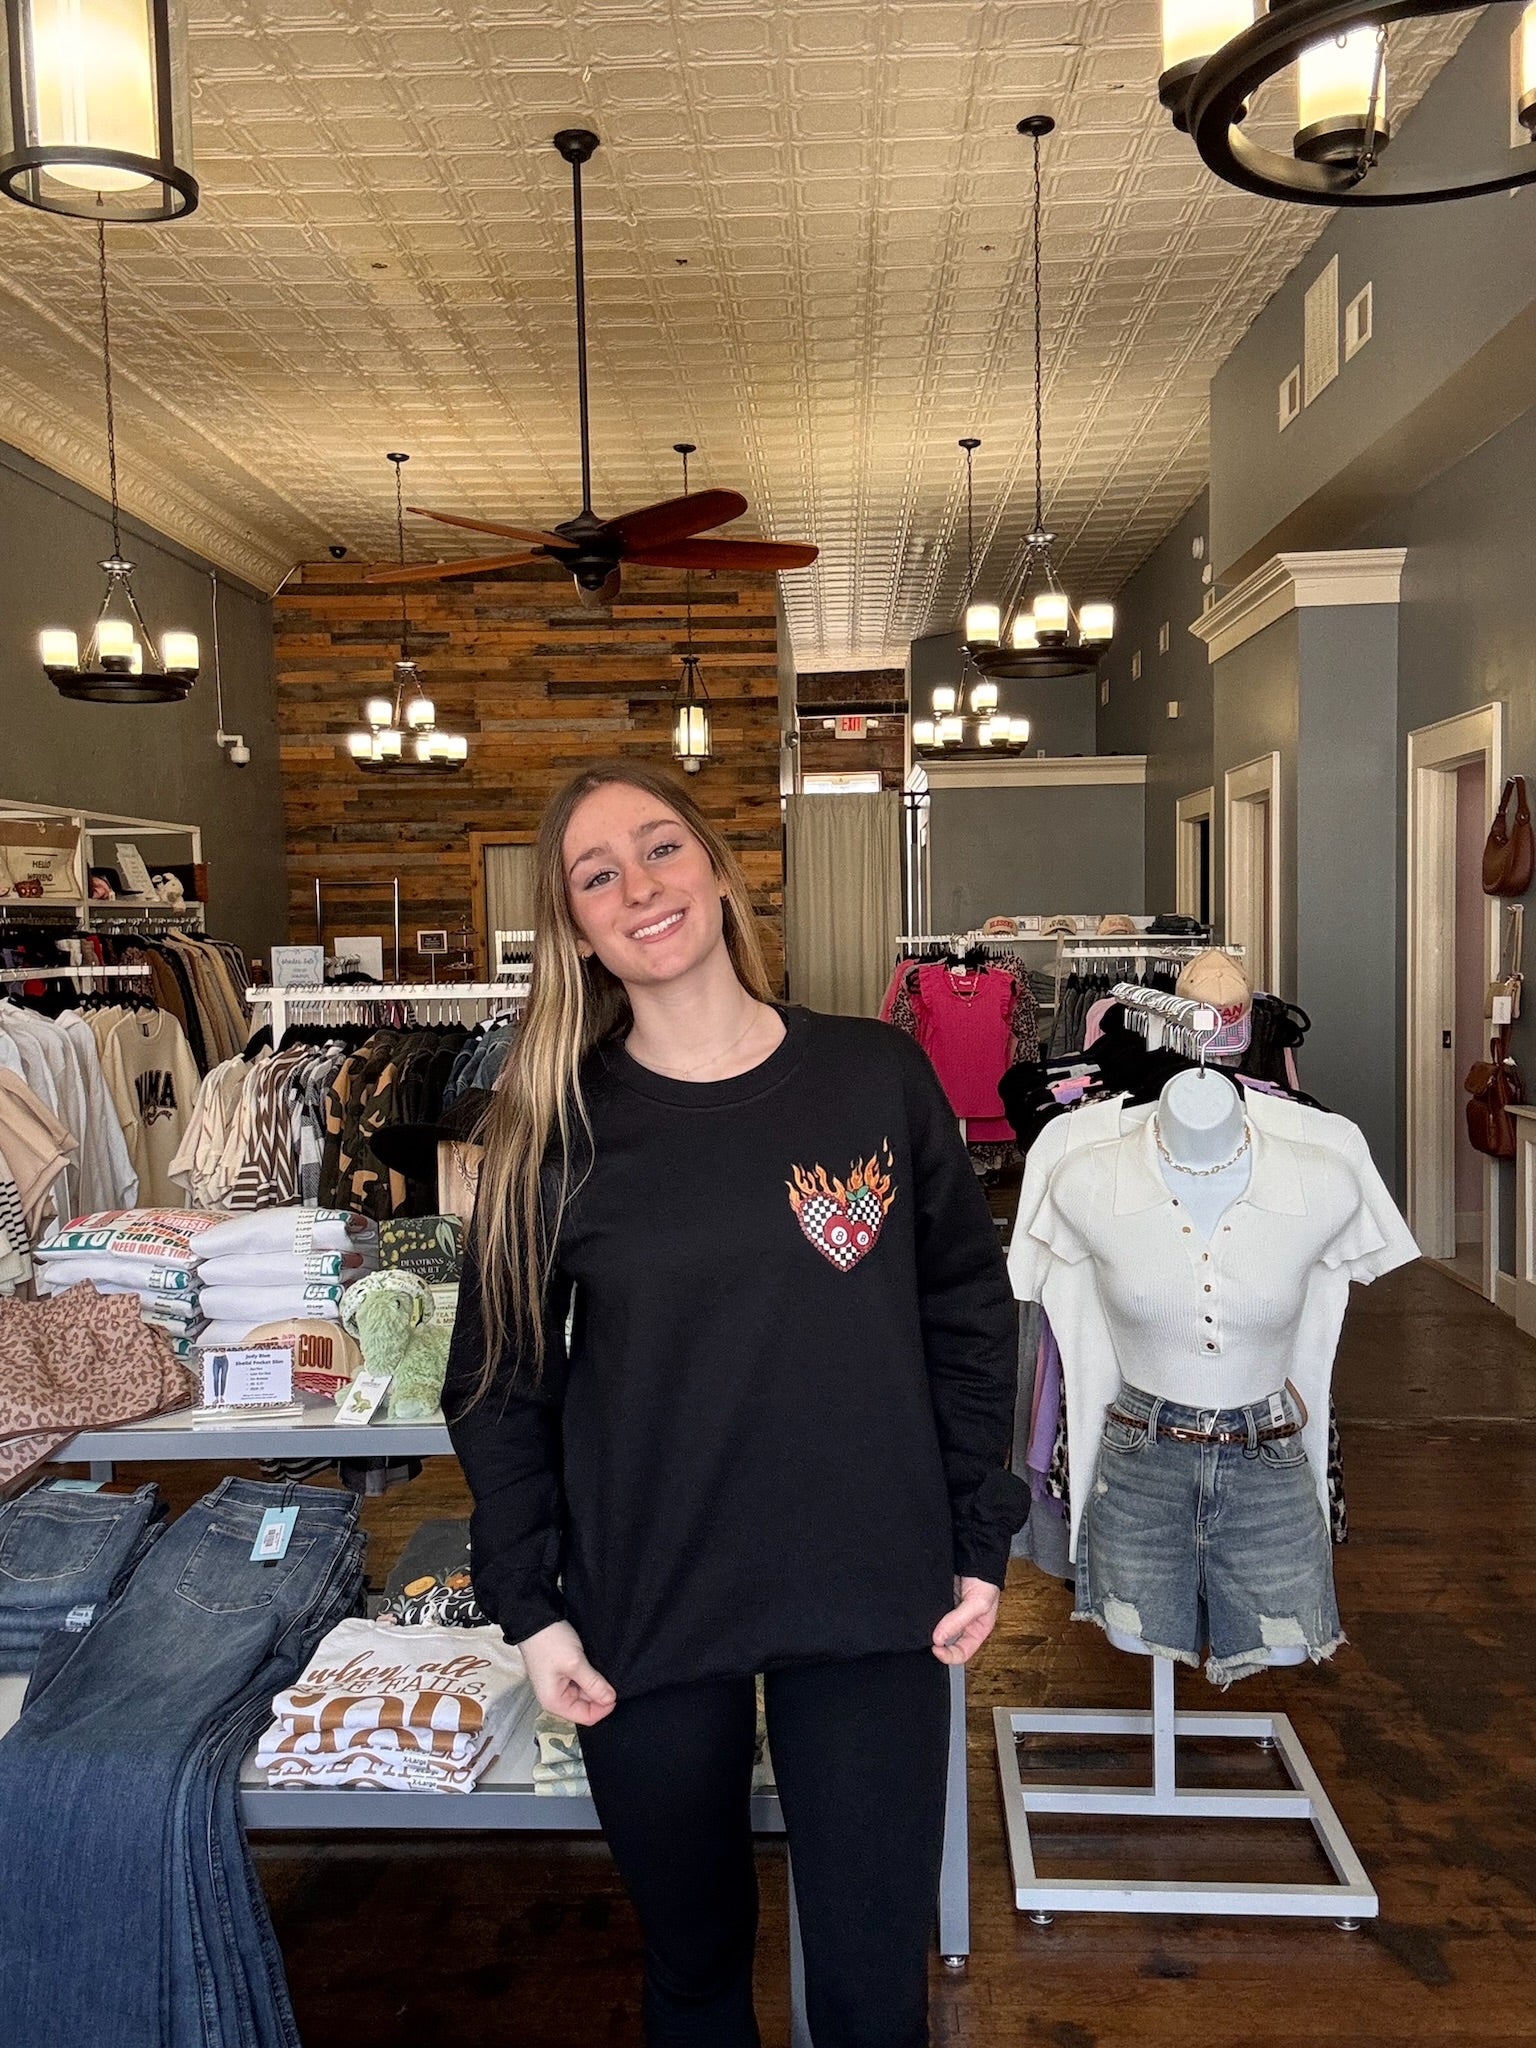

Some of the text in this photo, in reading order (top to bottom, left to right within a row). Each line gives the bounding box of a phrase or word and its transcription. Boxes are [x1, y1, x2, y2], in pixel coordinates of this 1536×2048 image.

[842, 717, 861, 731] EXIT
[32, 860, 51, 868] HELLO
[151, 1221, 184, 1234] KNOW
[77, 1230, 108, 1247] TO
[115, 1231, 161, 1243] START
[836, 1231, 867, 1243] 8 8
[111, 1240, 137, 1252] NEED
[137, 1242, 167, 1256] MORE
[401, 1257, 445, 1267] DEVOTIONS
[299, 1334, 333, 1369] GOOD
[307, 1650, 492, 1684] when all
[378, 1675, 488, 1702] FAILS,
[403, 1756, 427, 1766] X-Large
[412, 1779, 437, 1788] X-Large
